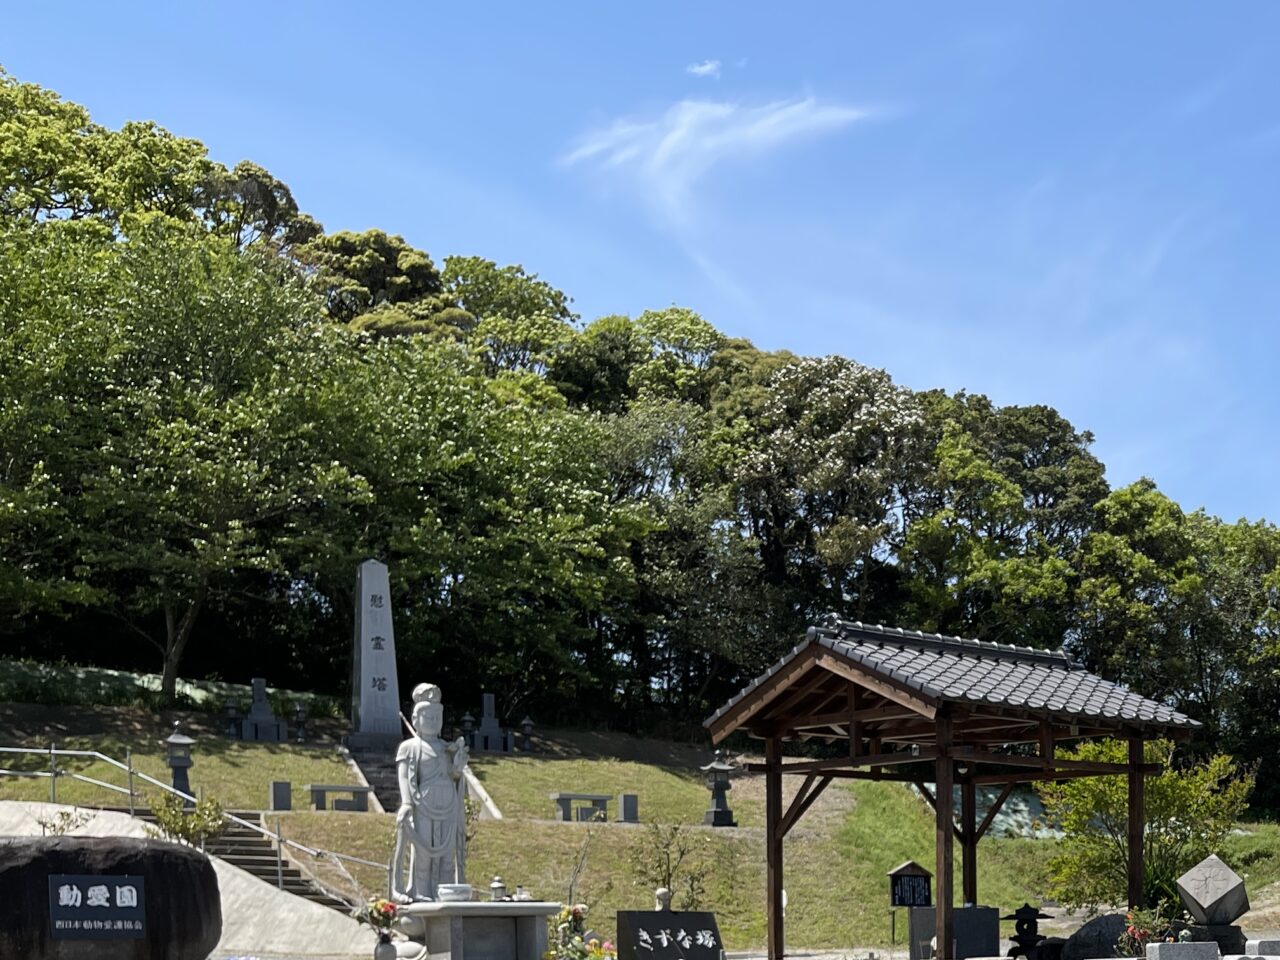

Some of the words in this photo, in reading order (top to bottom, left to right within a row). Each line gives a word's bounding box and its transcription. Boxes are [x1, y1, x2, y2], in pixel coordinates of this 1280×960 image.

[370, 594, 388, 692] 慰霊塔
[58, 884, 138, 908] 動愛園
[638, 927, 717, 951] きずな塚
